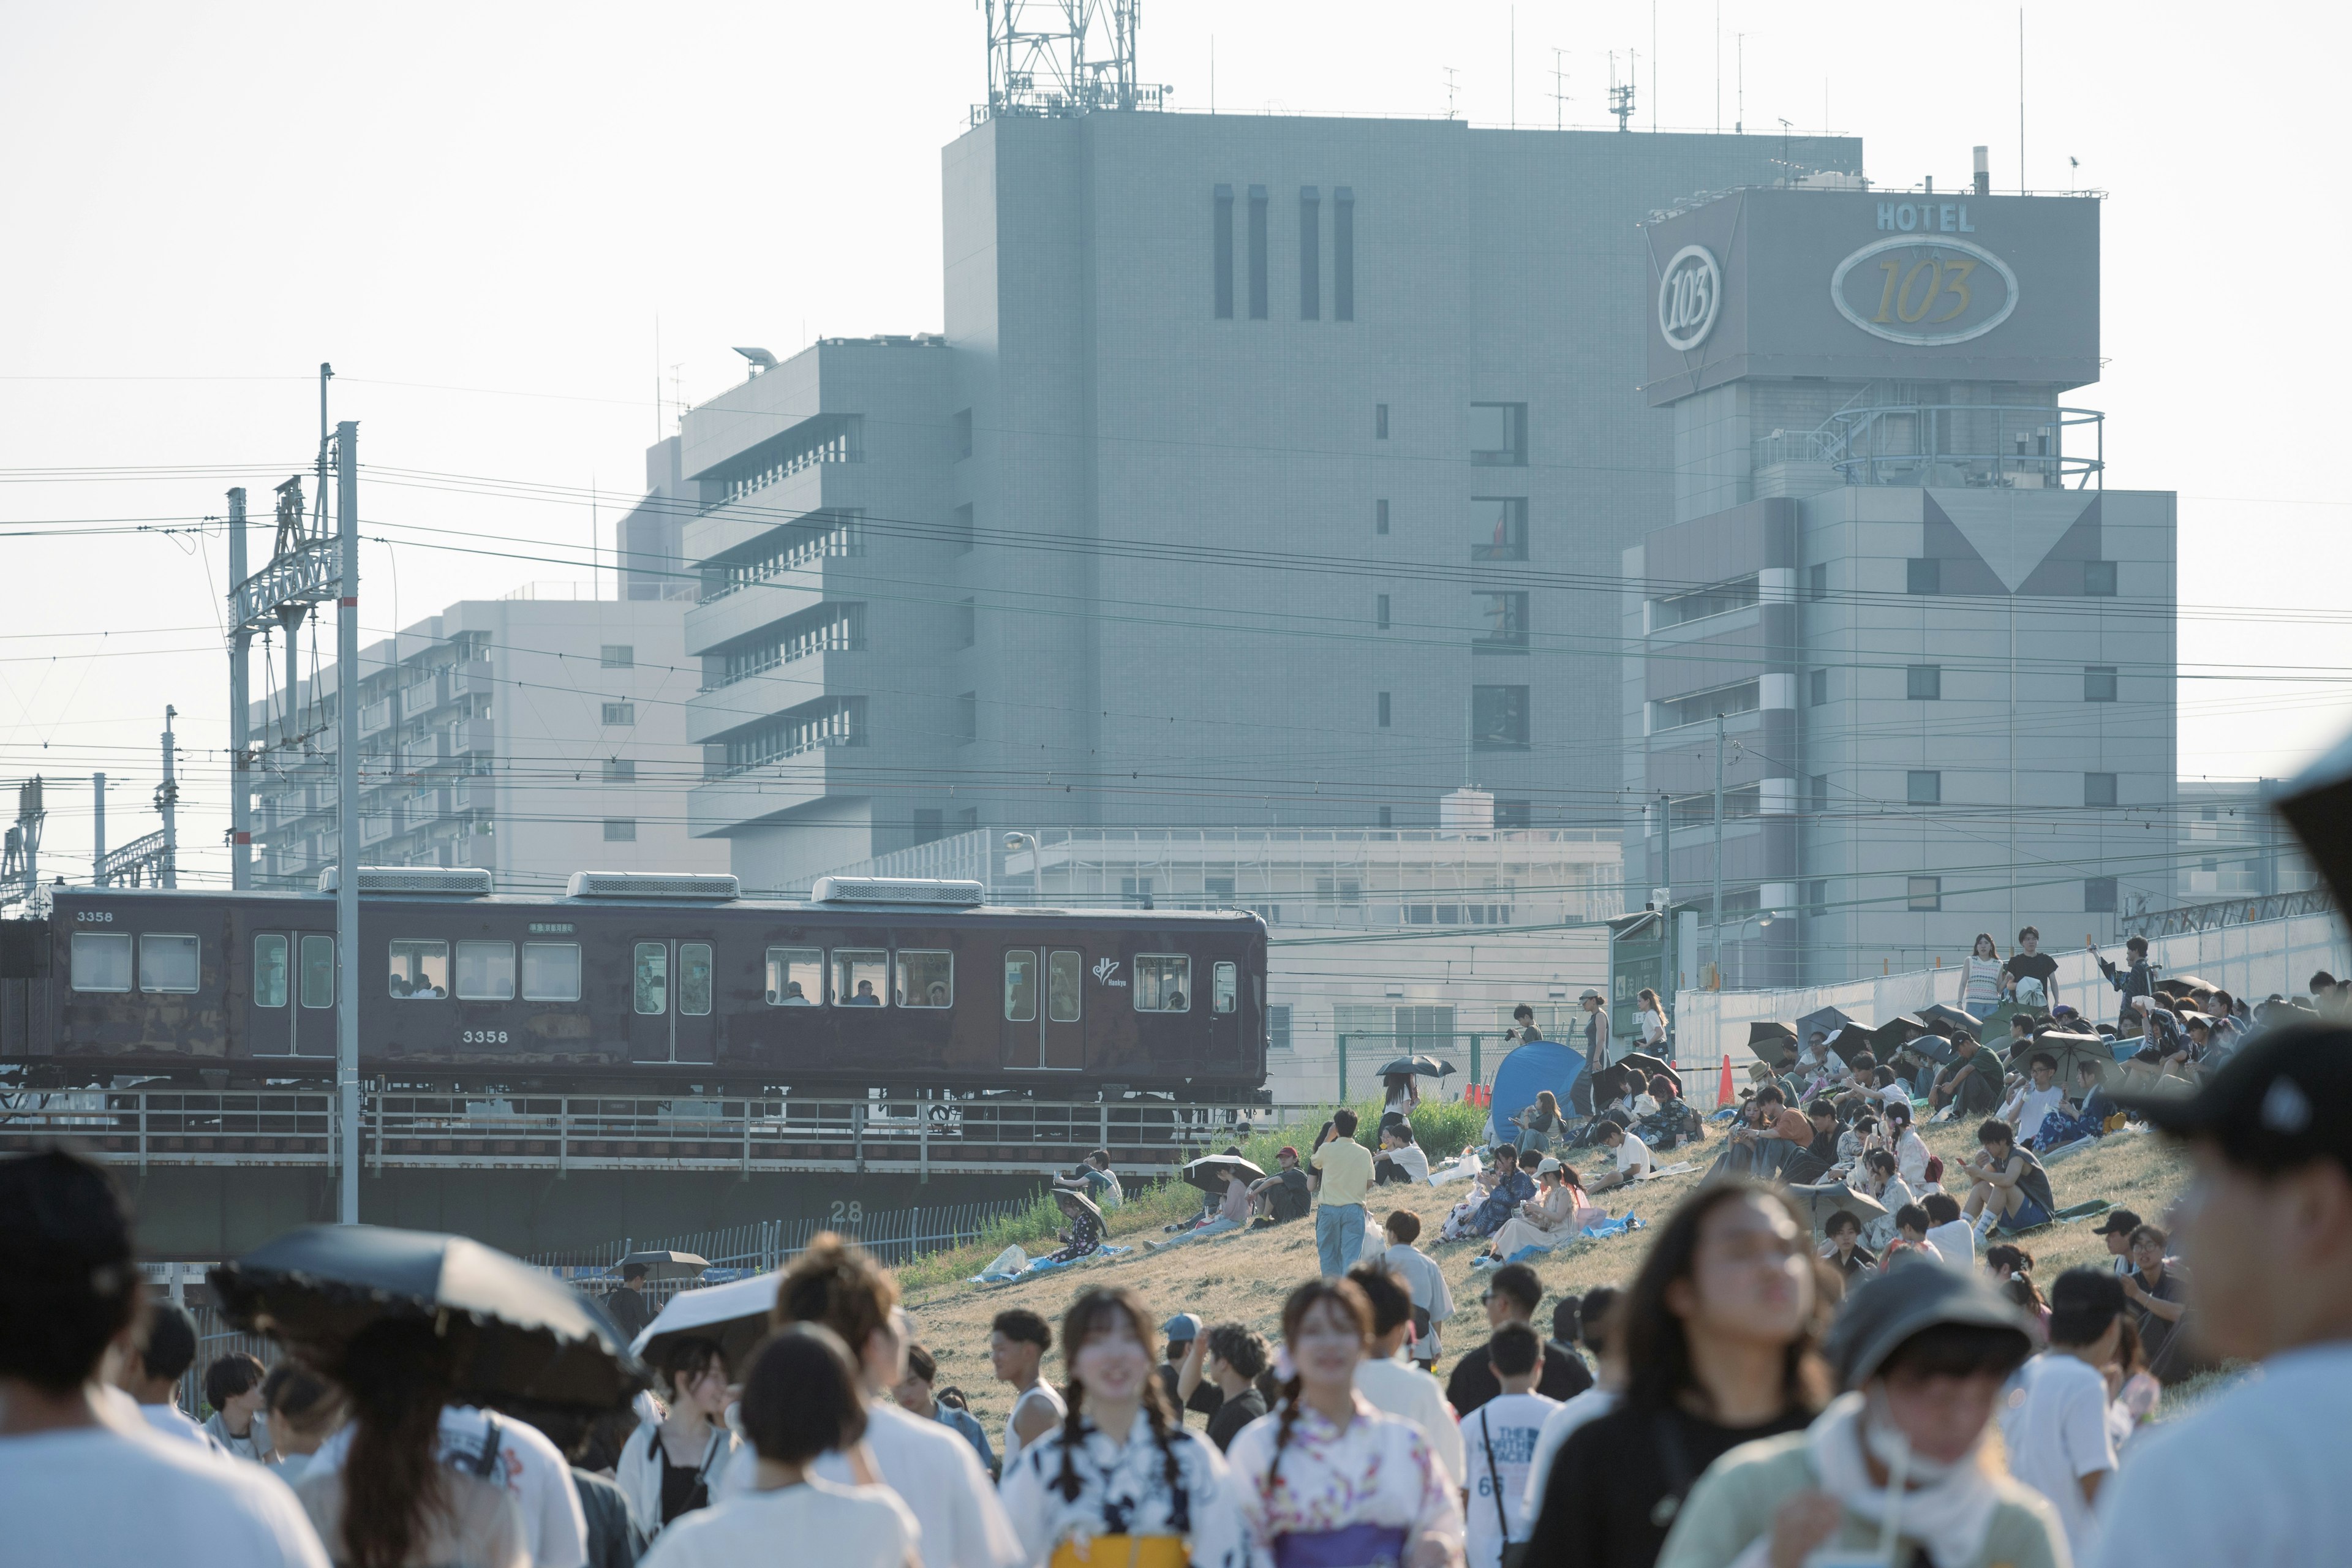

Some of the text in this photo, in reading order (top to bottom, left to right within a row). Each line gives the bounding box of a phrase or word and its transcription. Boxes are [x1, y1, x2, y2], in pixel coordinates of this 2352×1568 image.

[1877, 201, 1975, 232] HOTEL
[1667, 264, 1711, 332] 103
[1870, 258, 1981, 323] 103
[77, 911, 113, 922] 3358
[462, 1030, 508, 1043] 3358
[831, 1200, 862, 1222] 28
[1499, 1426, 1527, 1439] THE
